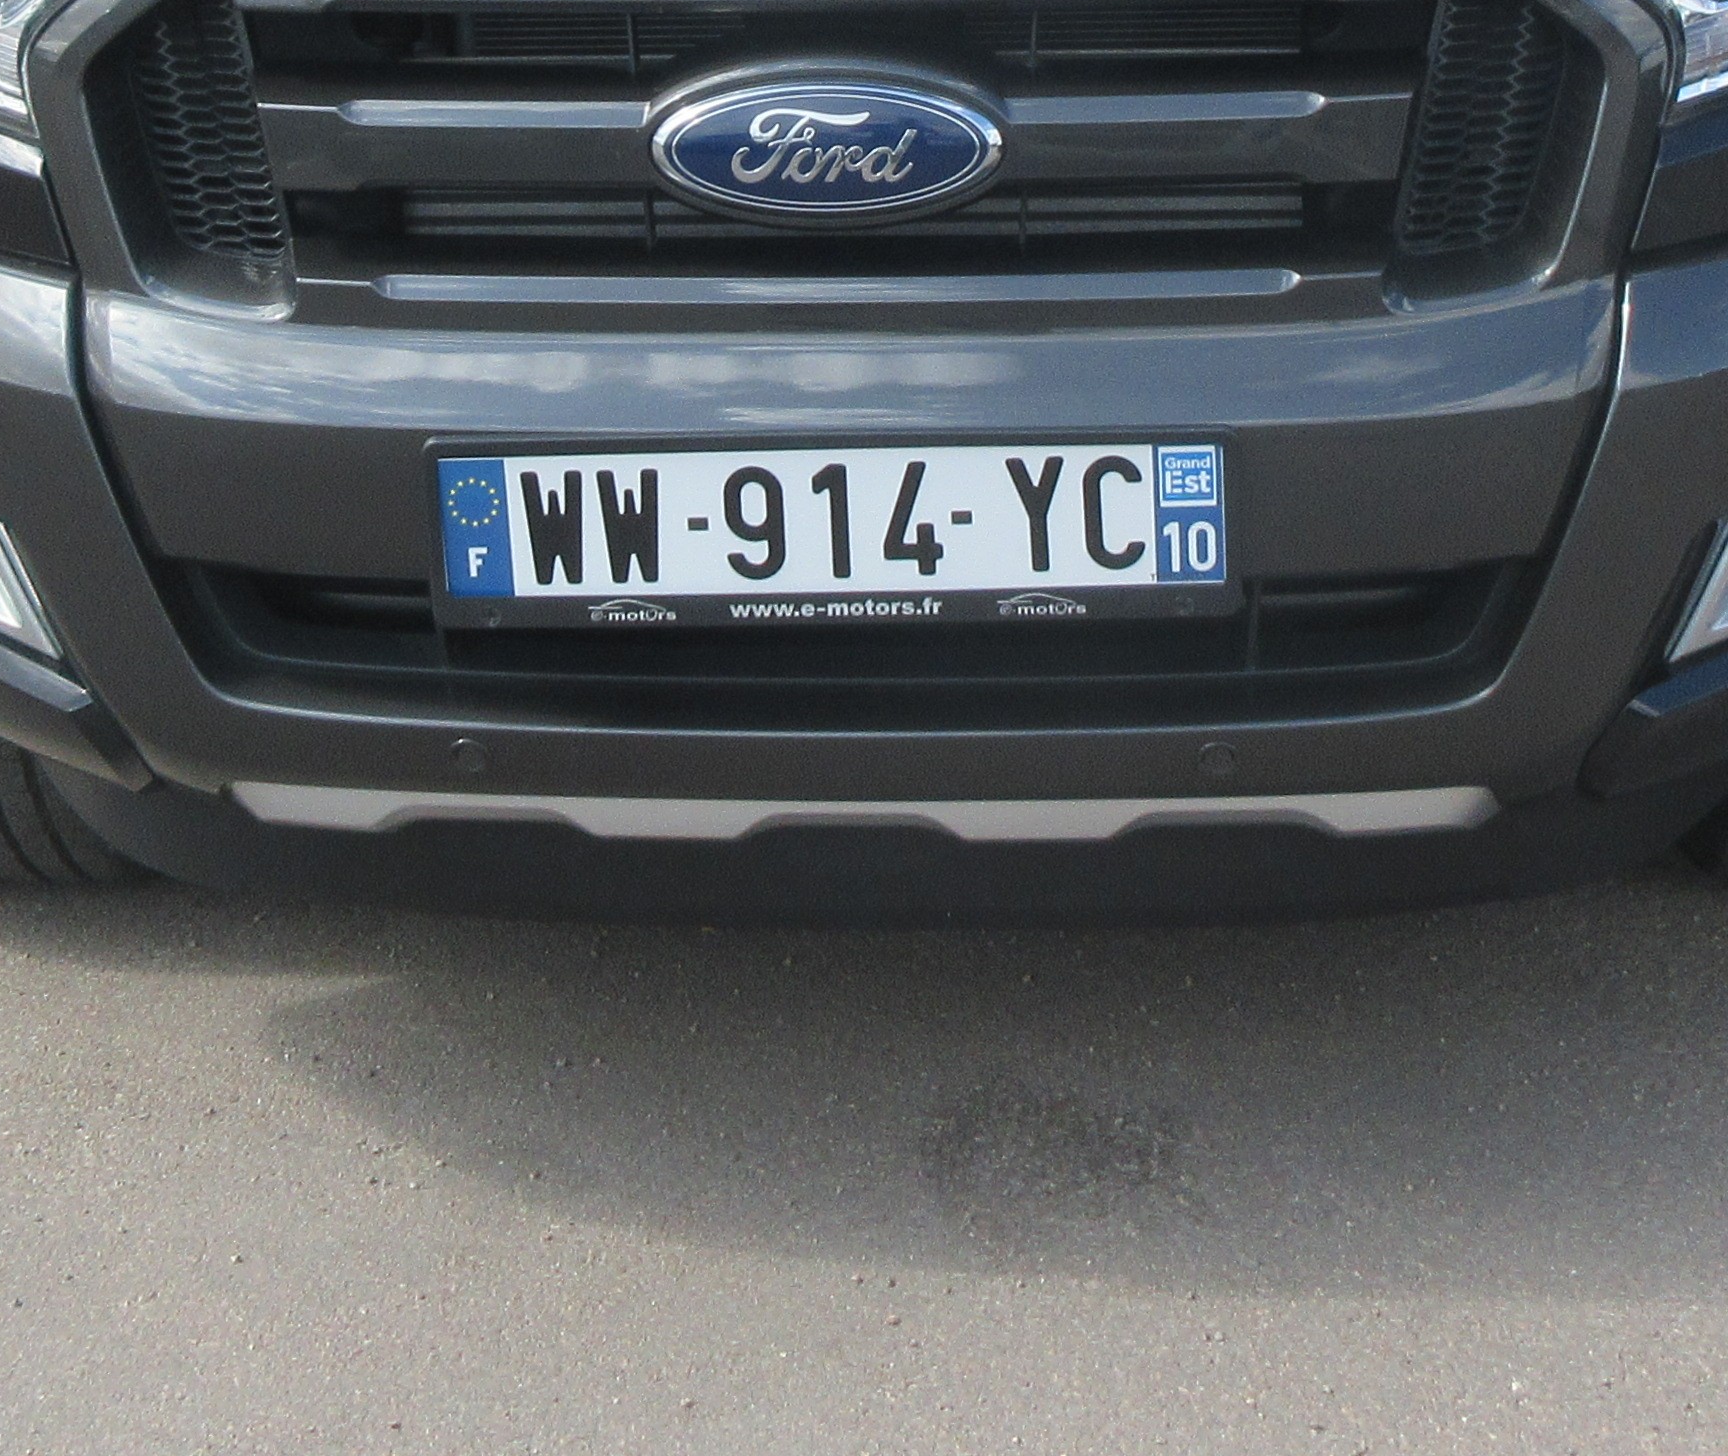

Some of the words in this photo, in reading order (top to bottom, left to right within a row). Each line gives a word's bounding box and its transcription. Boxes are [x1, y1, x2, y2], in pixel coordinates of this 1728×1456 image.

[731, 108, 917, 183] Ford
[1164, 457, 1211, 469] Grand
[1164, 471, 1212, 495] Est
[1162, 521, 1217, 573] 10
[467, 547, 488, 578] F
[729, 597, 943, 619] www.e-motors.fr
